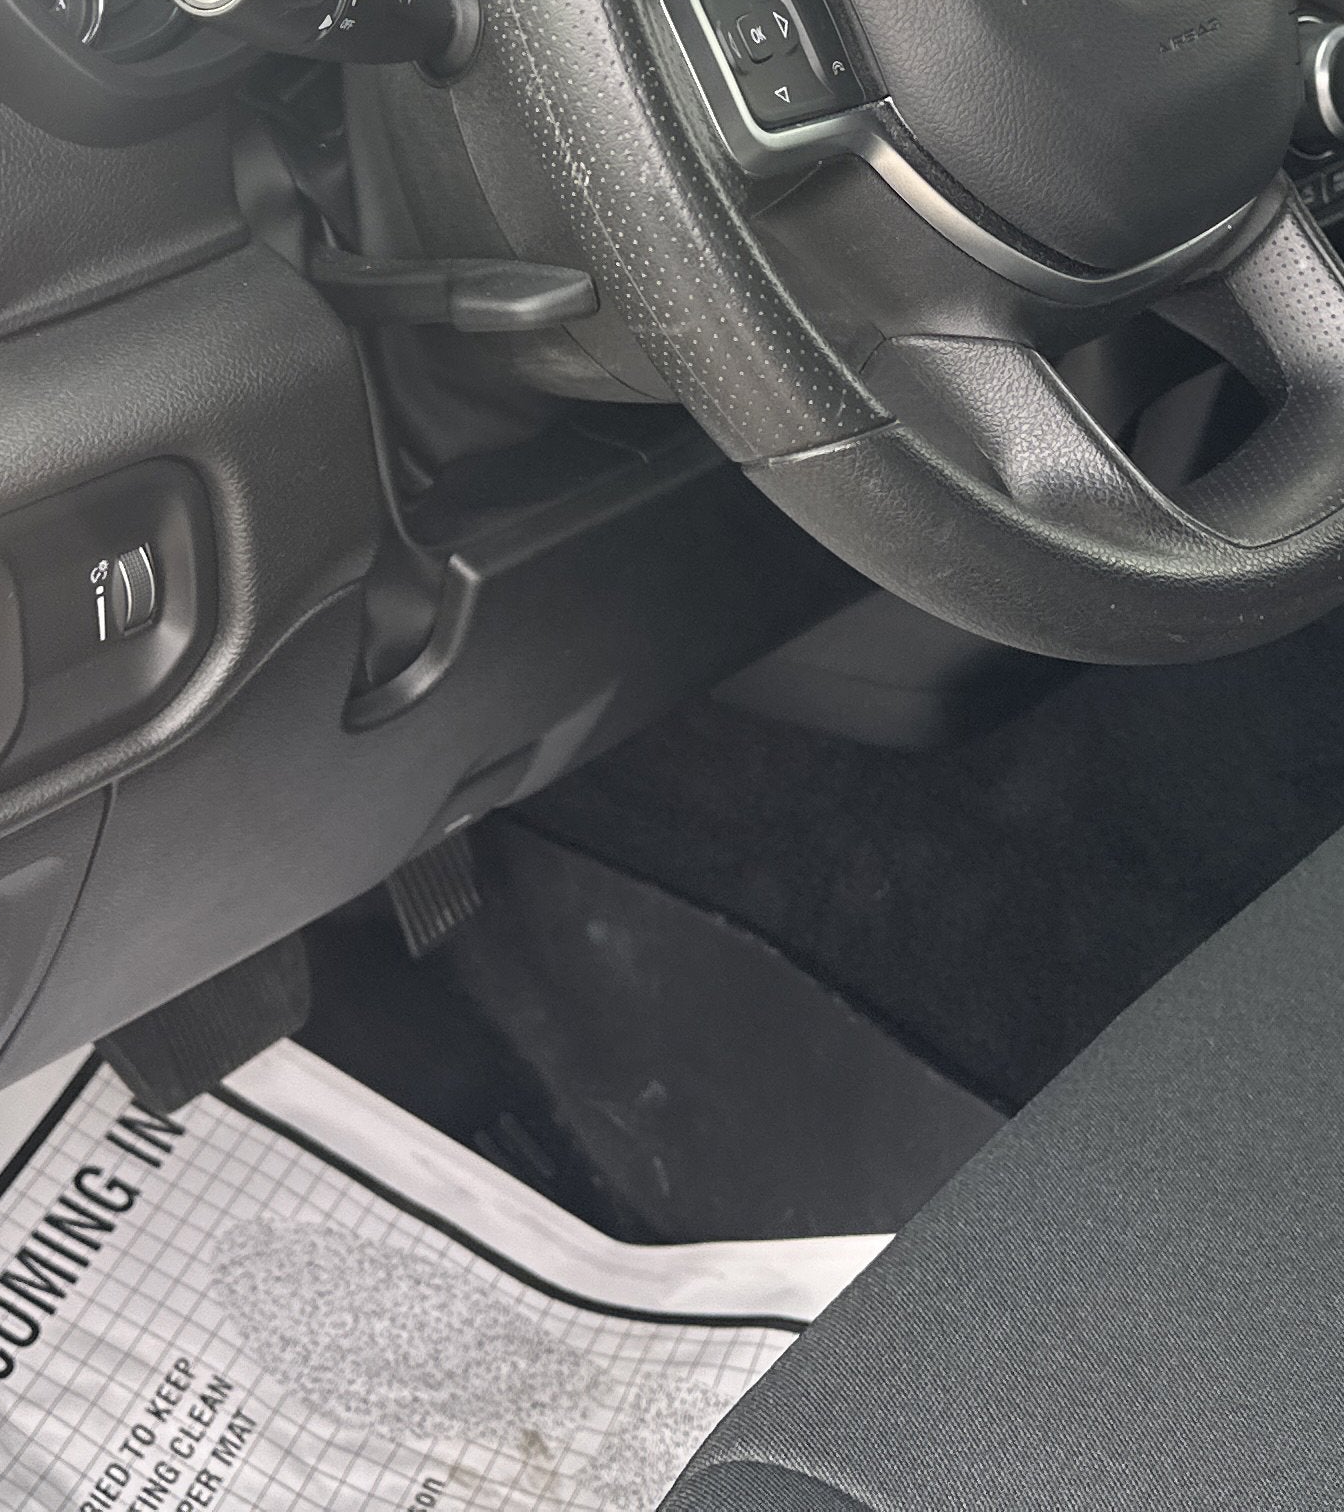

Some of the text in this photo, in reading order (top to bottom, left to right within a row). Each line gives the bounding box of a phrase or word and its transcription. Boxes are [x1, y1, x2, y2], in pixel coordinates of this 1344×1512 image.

[750, 26, 767, 44] OK
[105, 1099, 186, 1168] IN
[119, 1423, 157, 1460] TO
[145, 1356, 196, 1424] KEEP
[169, 1374, 234, 1459] CLEAN
[211, 1407, 257, 1467] MAT
[407, 1477, 446, 1512] on
